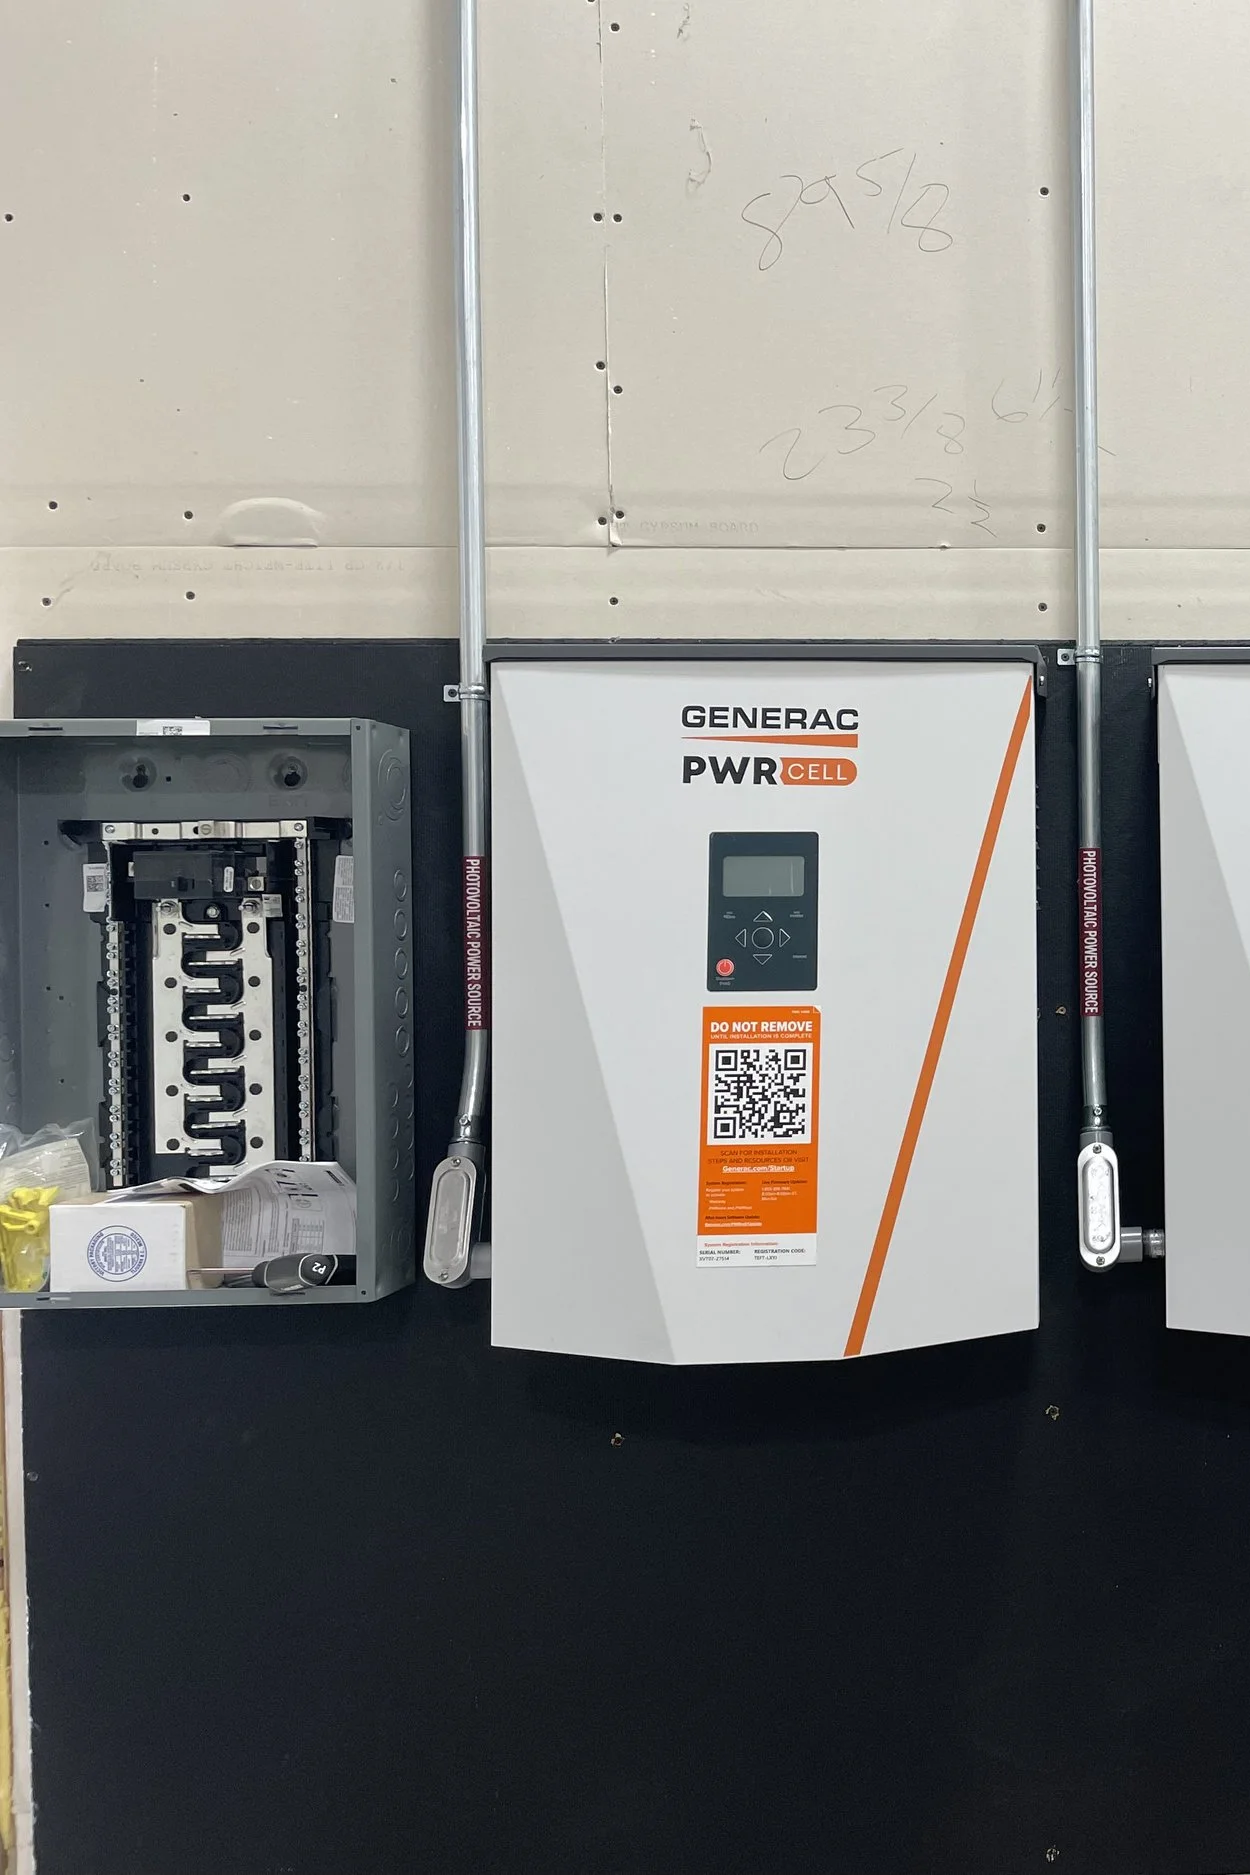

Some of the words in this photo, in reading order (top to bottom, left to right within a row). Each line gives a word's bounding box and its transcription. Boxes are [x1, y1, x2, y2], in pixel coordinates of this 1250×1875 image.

[709, 521, 760, 534] BOARD
[681, 705, 859, 731] GENERAC
[466, 859, 481, 939] PHOTOVOLTAIC
[1083, 850, 1098, 928] PHOTOVOLTAIC
[466, 941, 481, 981] POWER
[1084, 930, 1098, 969] POWER
[467, 983, 482, 1027] SOURCE
[1085, 971, 1099, 1014] SOURCE
[711, 1022, 729, 1033] DO
[732, 1022, 758, 1032] NOT
[761, 1021, 813, 1032] REMOVE
[722, 1165, 796, 1174] Generac.com/Startup
[312, 1262, 327, 1275] P2
